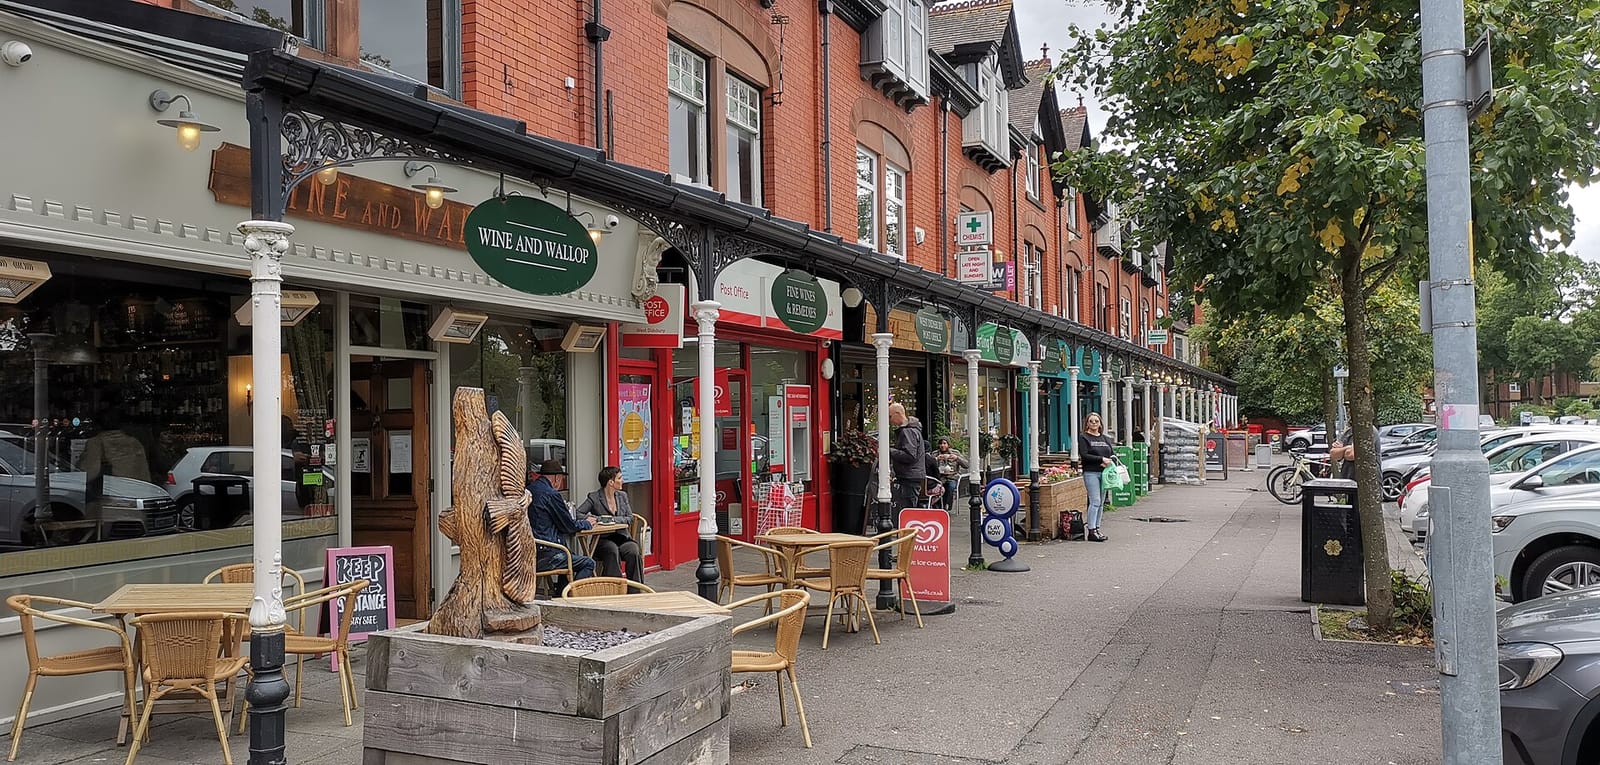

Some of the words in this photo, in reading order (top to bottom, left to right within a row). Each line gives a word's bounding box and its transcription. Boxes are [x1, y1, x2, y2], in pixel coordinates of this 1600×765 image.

[288, 172, 351, 218] INE
[361, 201, 400, 230] AND
[413, 197, 472, 244] WAL
[478, 226, 513, 250] WINE
[516, 235, 543, 255] AND
[545, 240, 589, 264] WALLOP
[962, 233, 985, 241] CHEMIST
[720, 282, 733, 296] Post
[734, 285, 749, 300] Office
[786, 285, 799, 299] FINE
[799, 287, 816, 302] WINES
[644, 309, 665, 317] FFICE
[786, 302, 792, 314] &
[792, 303, 817, 319] REMEDIES
[337, 554, 384, 584] KEEP
[337, 593, 386, 612] DTANCE
[362, 615, 377, 625] SAFE
